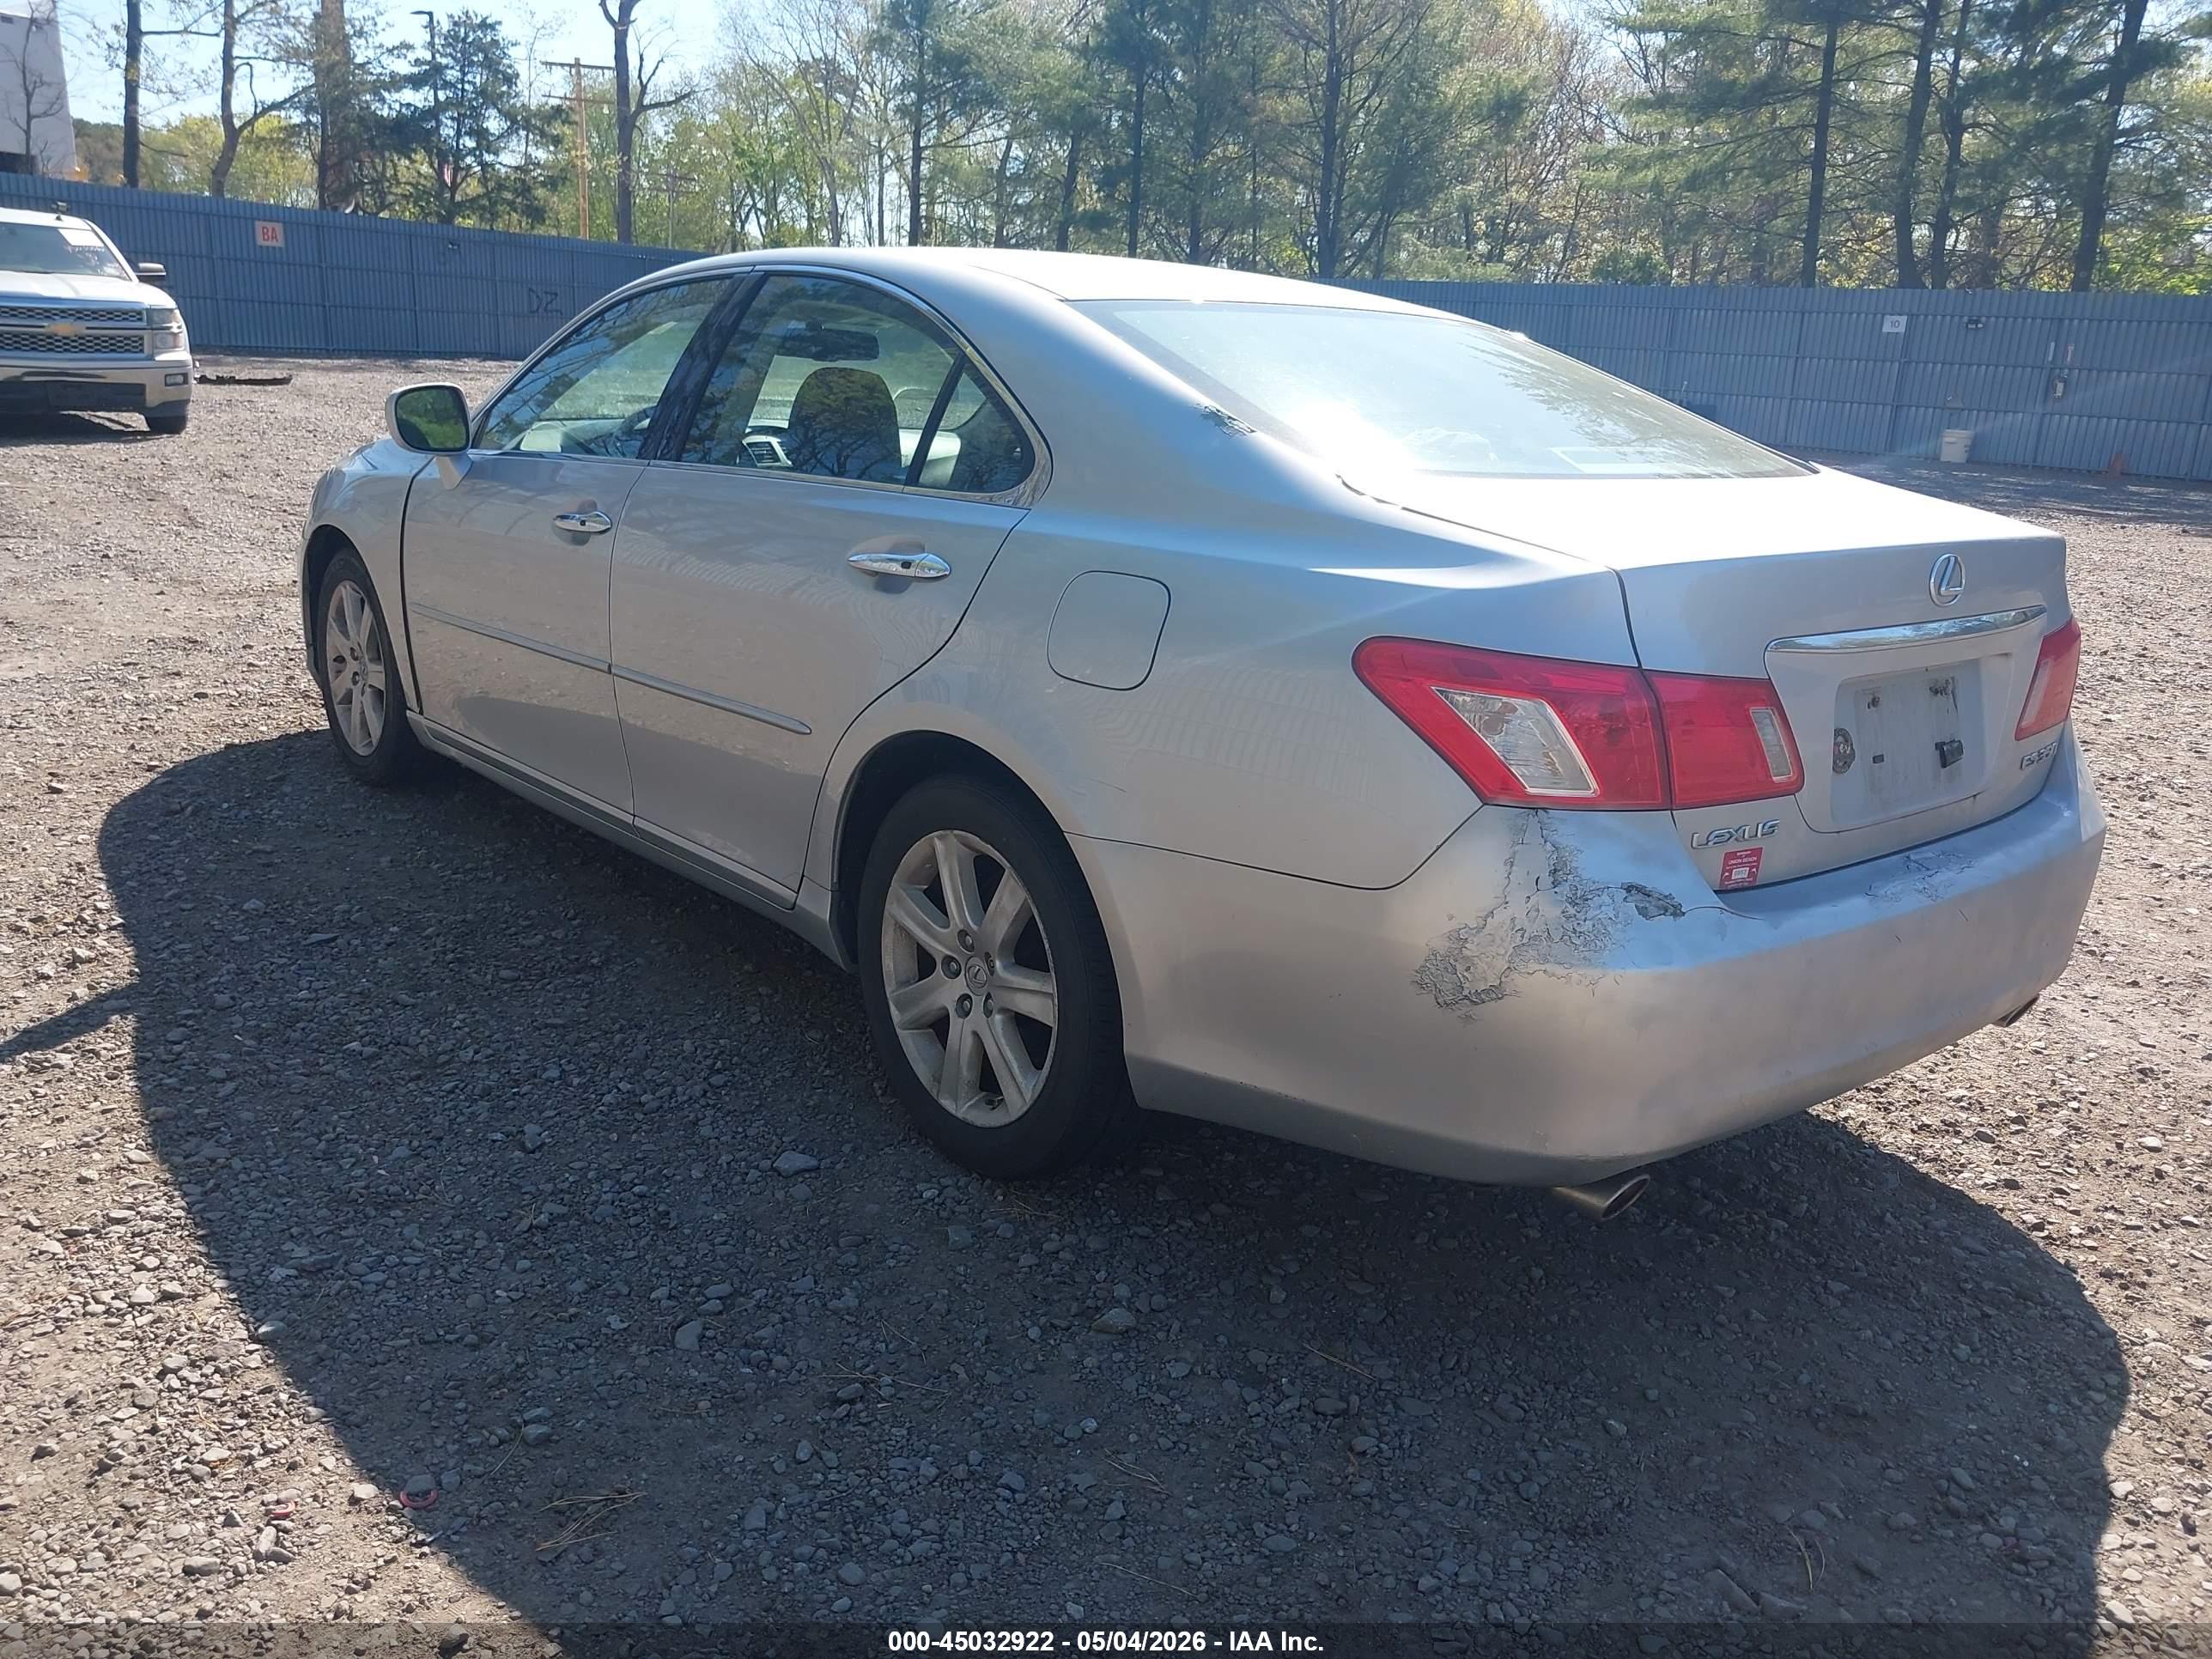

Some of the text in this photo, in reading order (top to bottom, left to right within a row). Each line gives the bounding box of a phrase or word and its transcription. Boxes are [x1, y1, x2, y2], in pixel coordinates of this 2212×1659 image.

[261, 226, 279, 242] BA
[1889, 319, 1900, 329] 10
[1691, 818, 1780, 850] LEXUS
